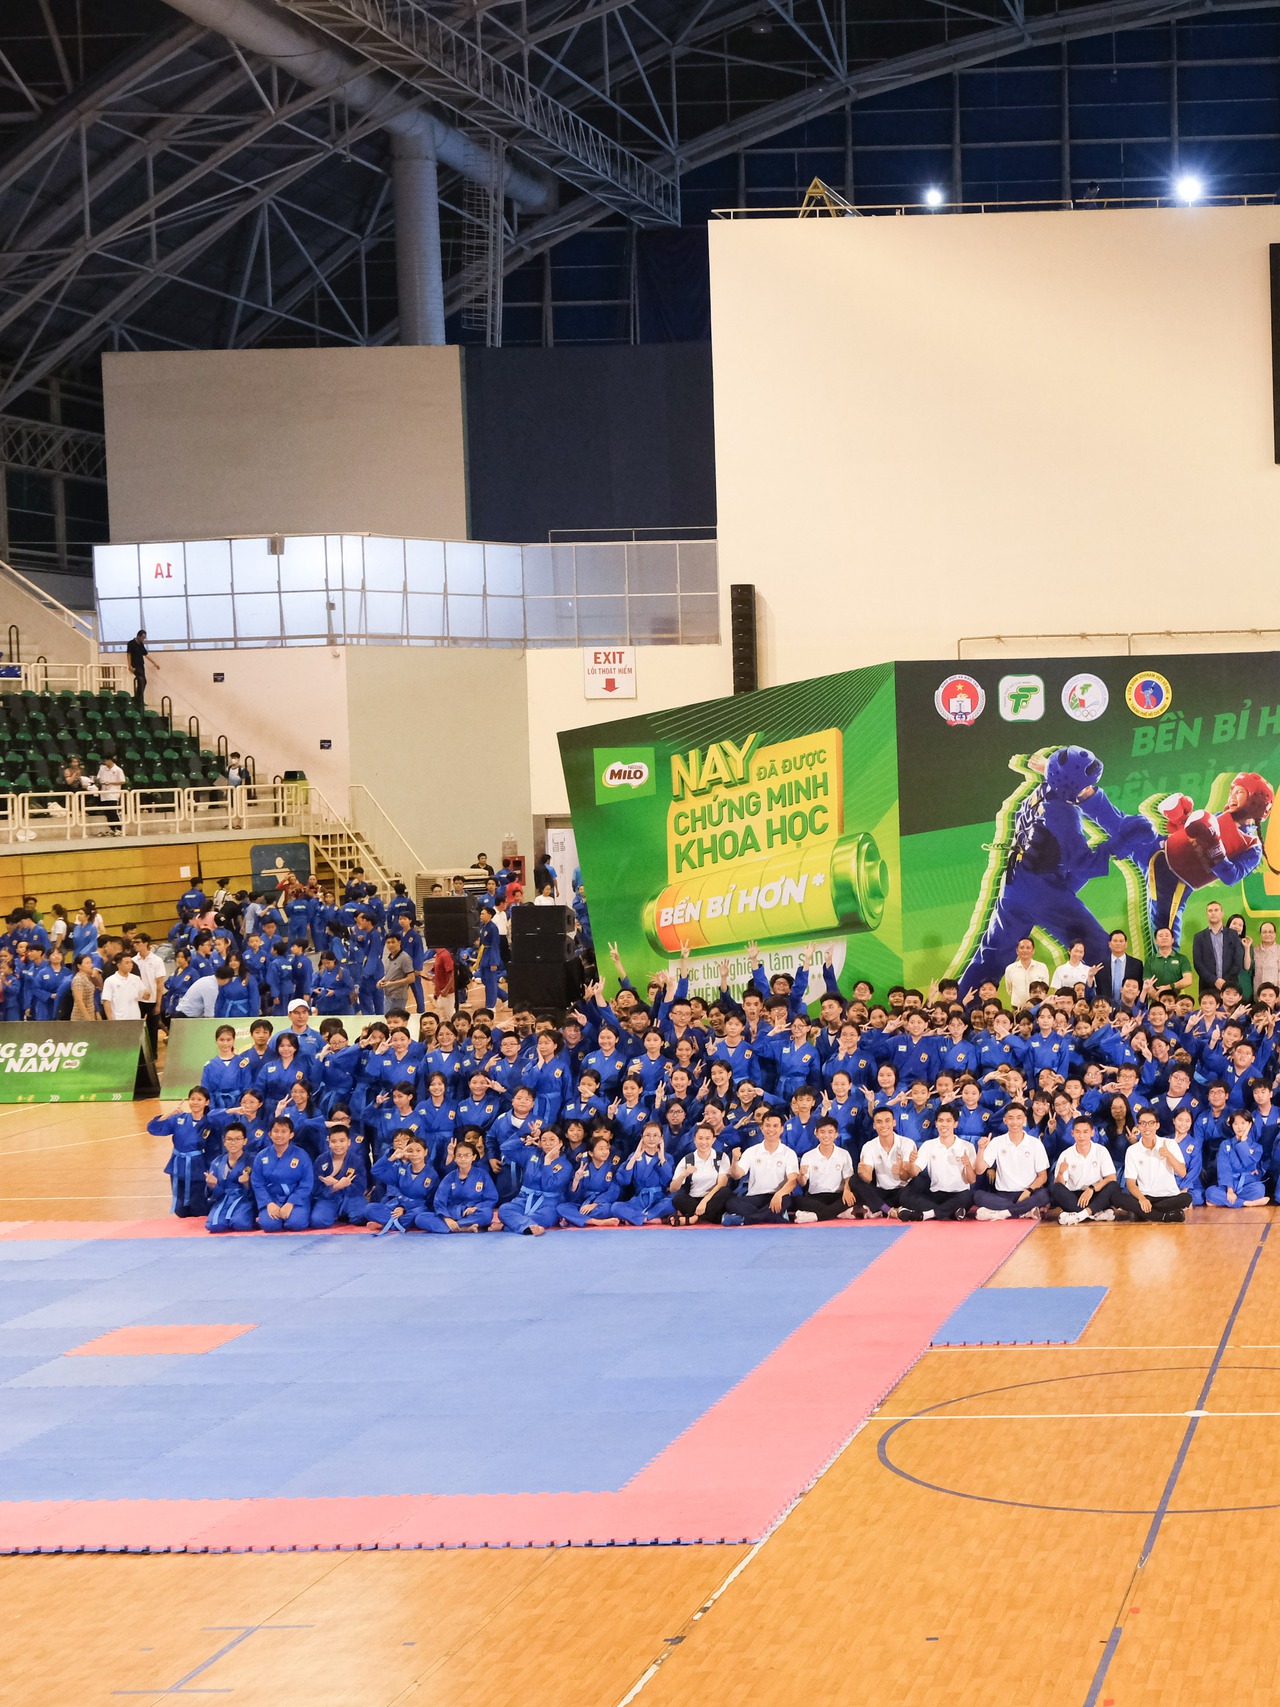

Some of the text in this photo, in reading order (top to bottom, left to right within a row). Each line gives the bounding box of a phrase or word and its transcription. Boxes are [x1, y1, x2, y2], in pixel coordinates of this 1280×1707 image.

[594, 652, 624, 664] EXIT
[1132, 710, 1202, 757] BỀN
[1212, 699, 1252, 744] BỈ
[609, 769, 644, 780] MILO
[671, 732, 827, 801] NAY ĐÃ ĐƯỢC
[674, 772, 828, 836] CHỨNG MINH
[675, 804, 829, 874] KHOA HỌC
[706, 884, 736, 918] BỈ
[769, 952, 794, 971] lâm
[4, 1058, 60, 1072] NAM
